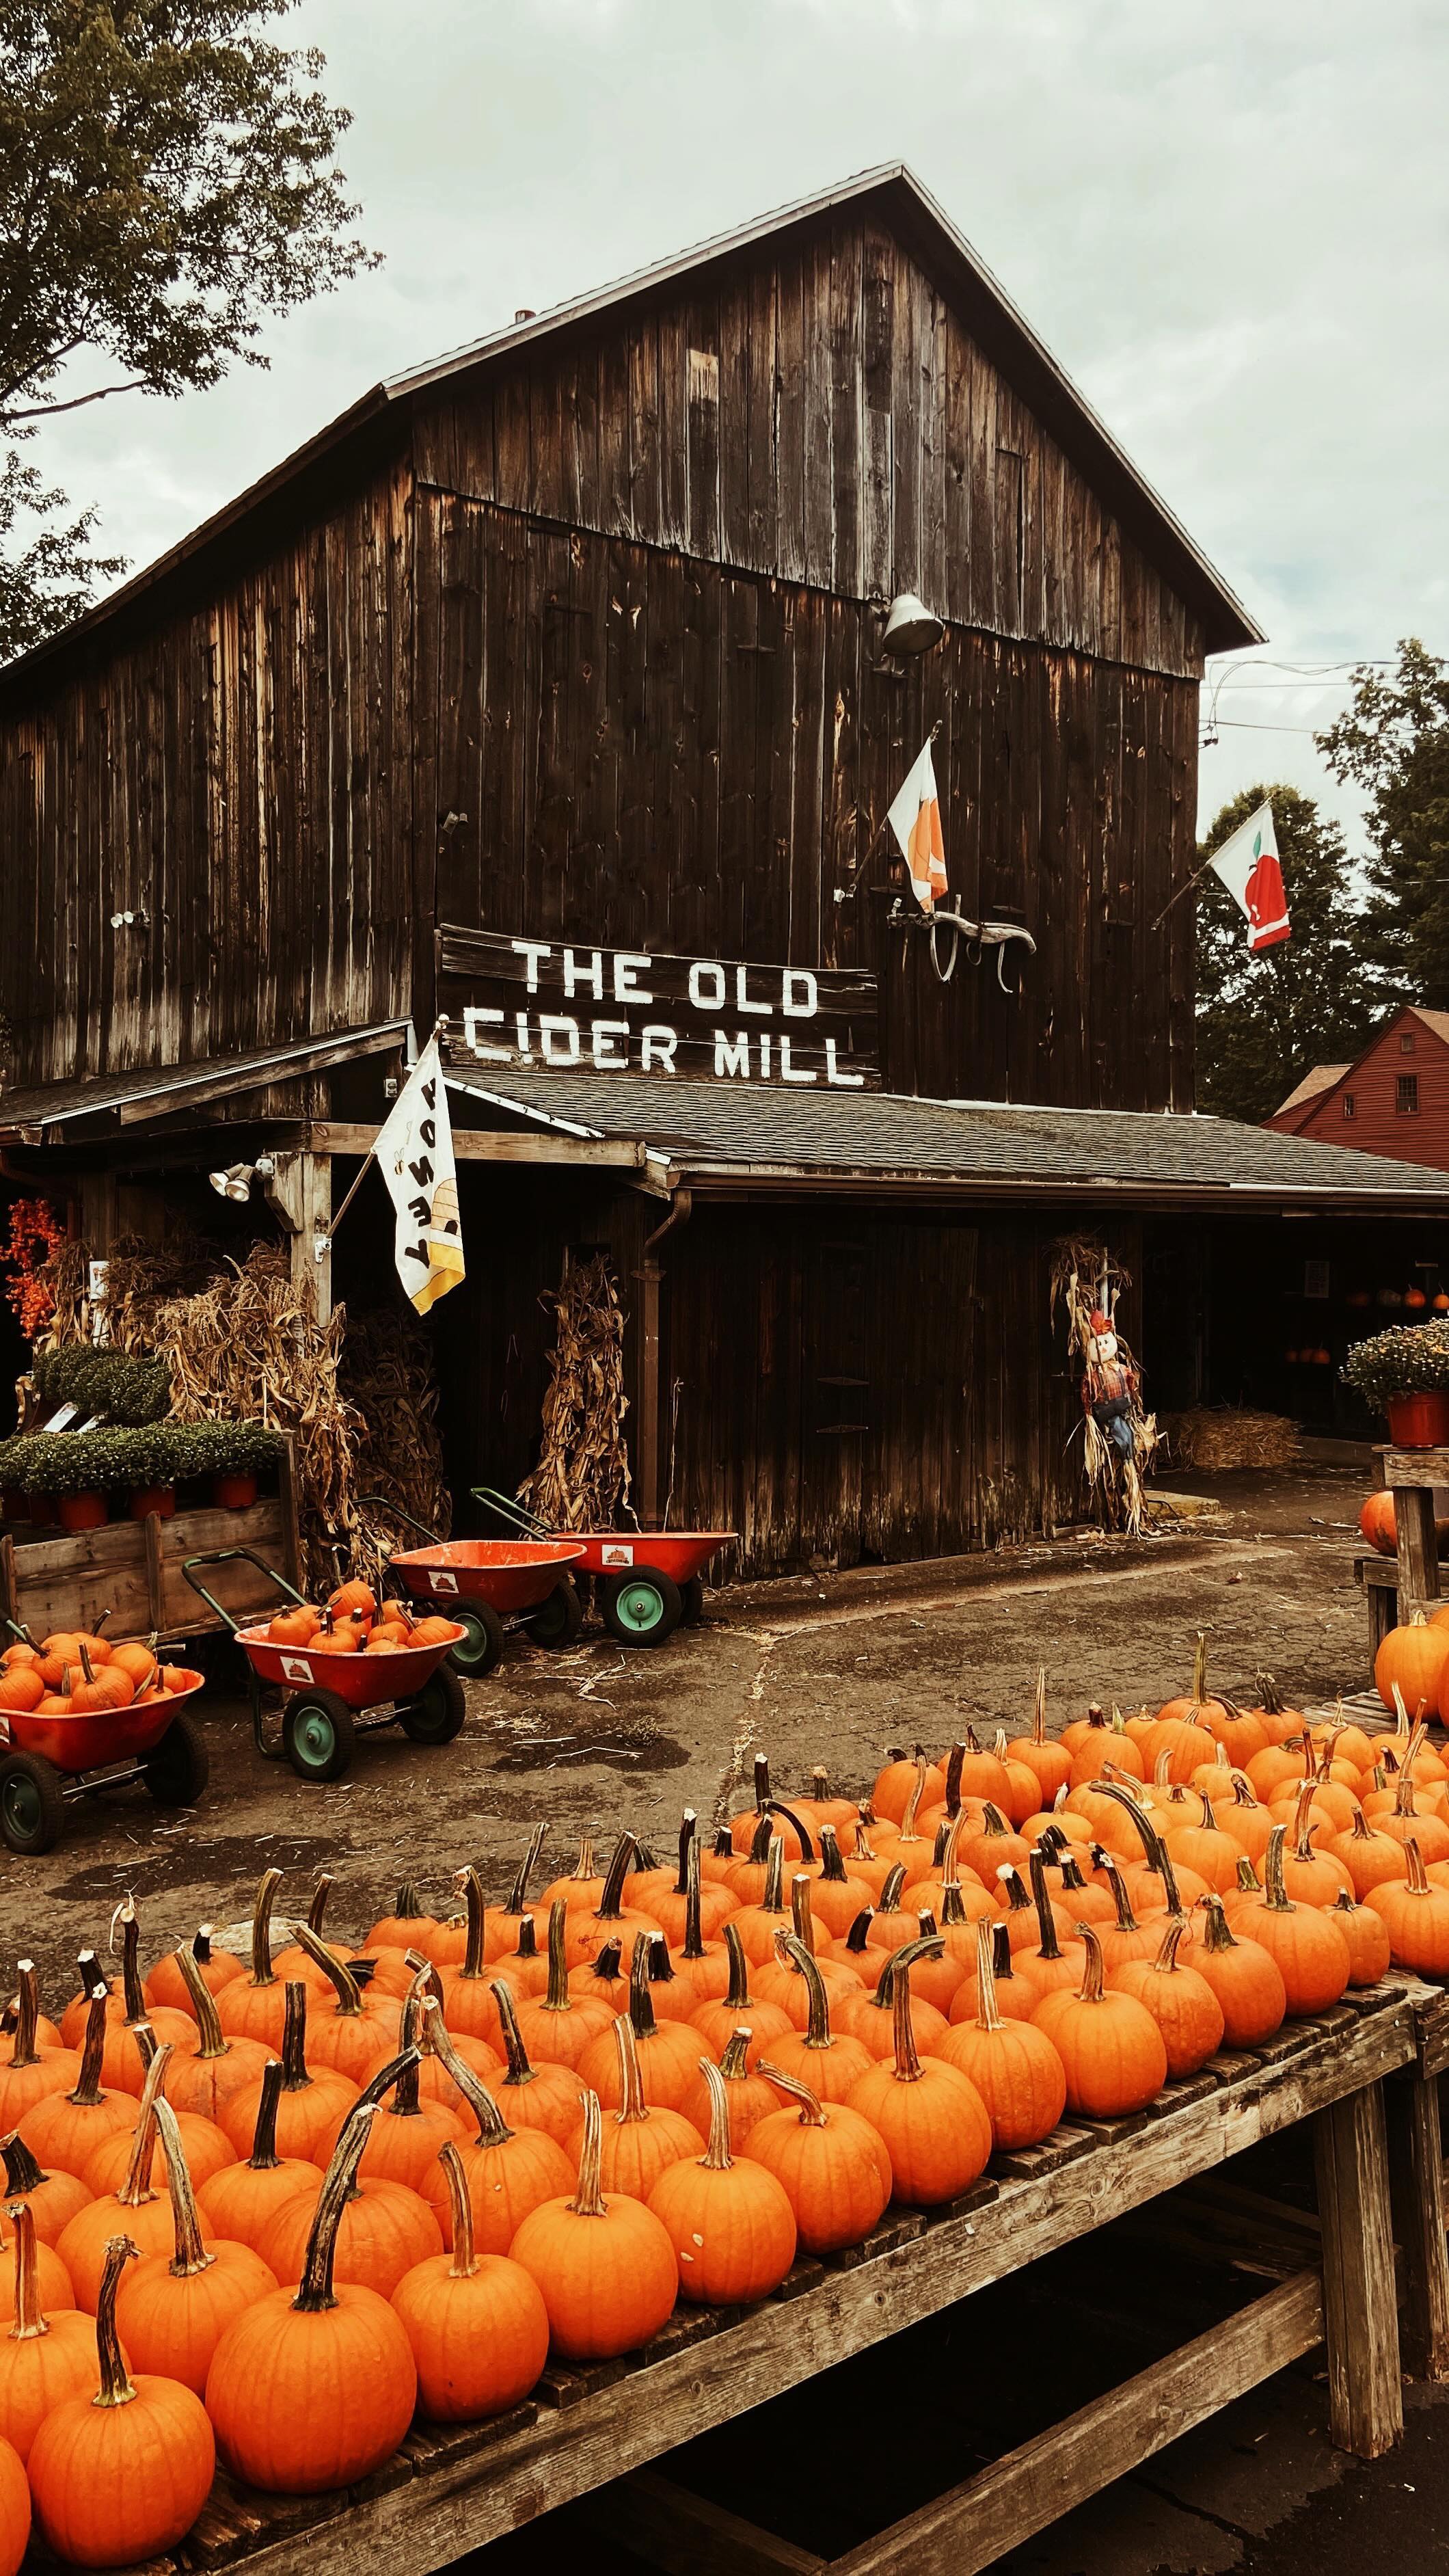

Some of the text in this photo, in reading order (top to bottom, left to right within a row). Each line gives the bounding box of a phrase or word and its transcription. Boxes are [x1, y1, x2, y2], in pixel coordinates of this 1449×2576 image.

[511, 941, 817, 1017] THE OLD
[463, 1008, 864, 1086] CIDER MILL
